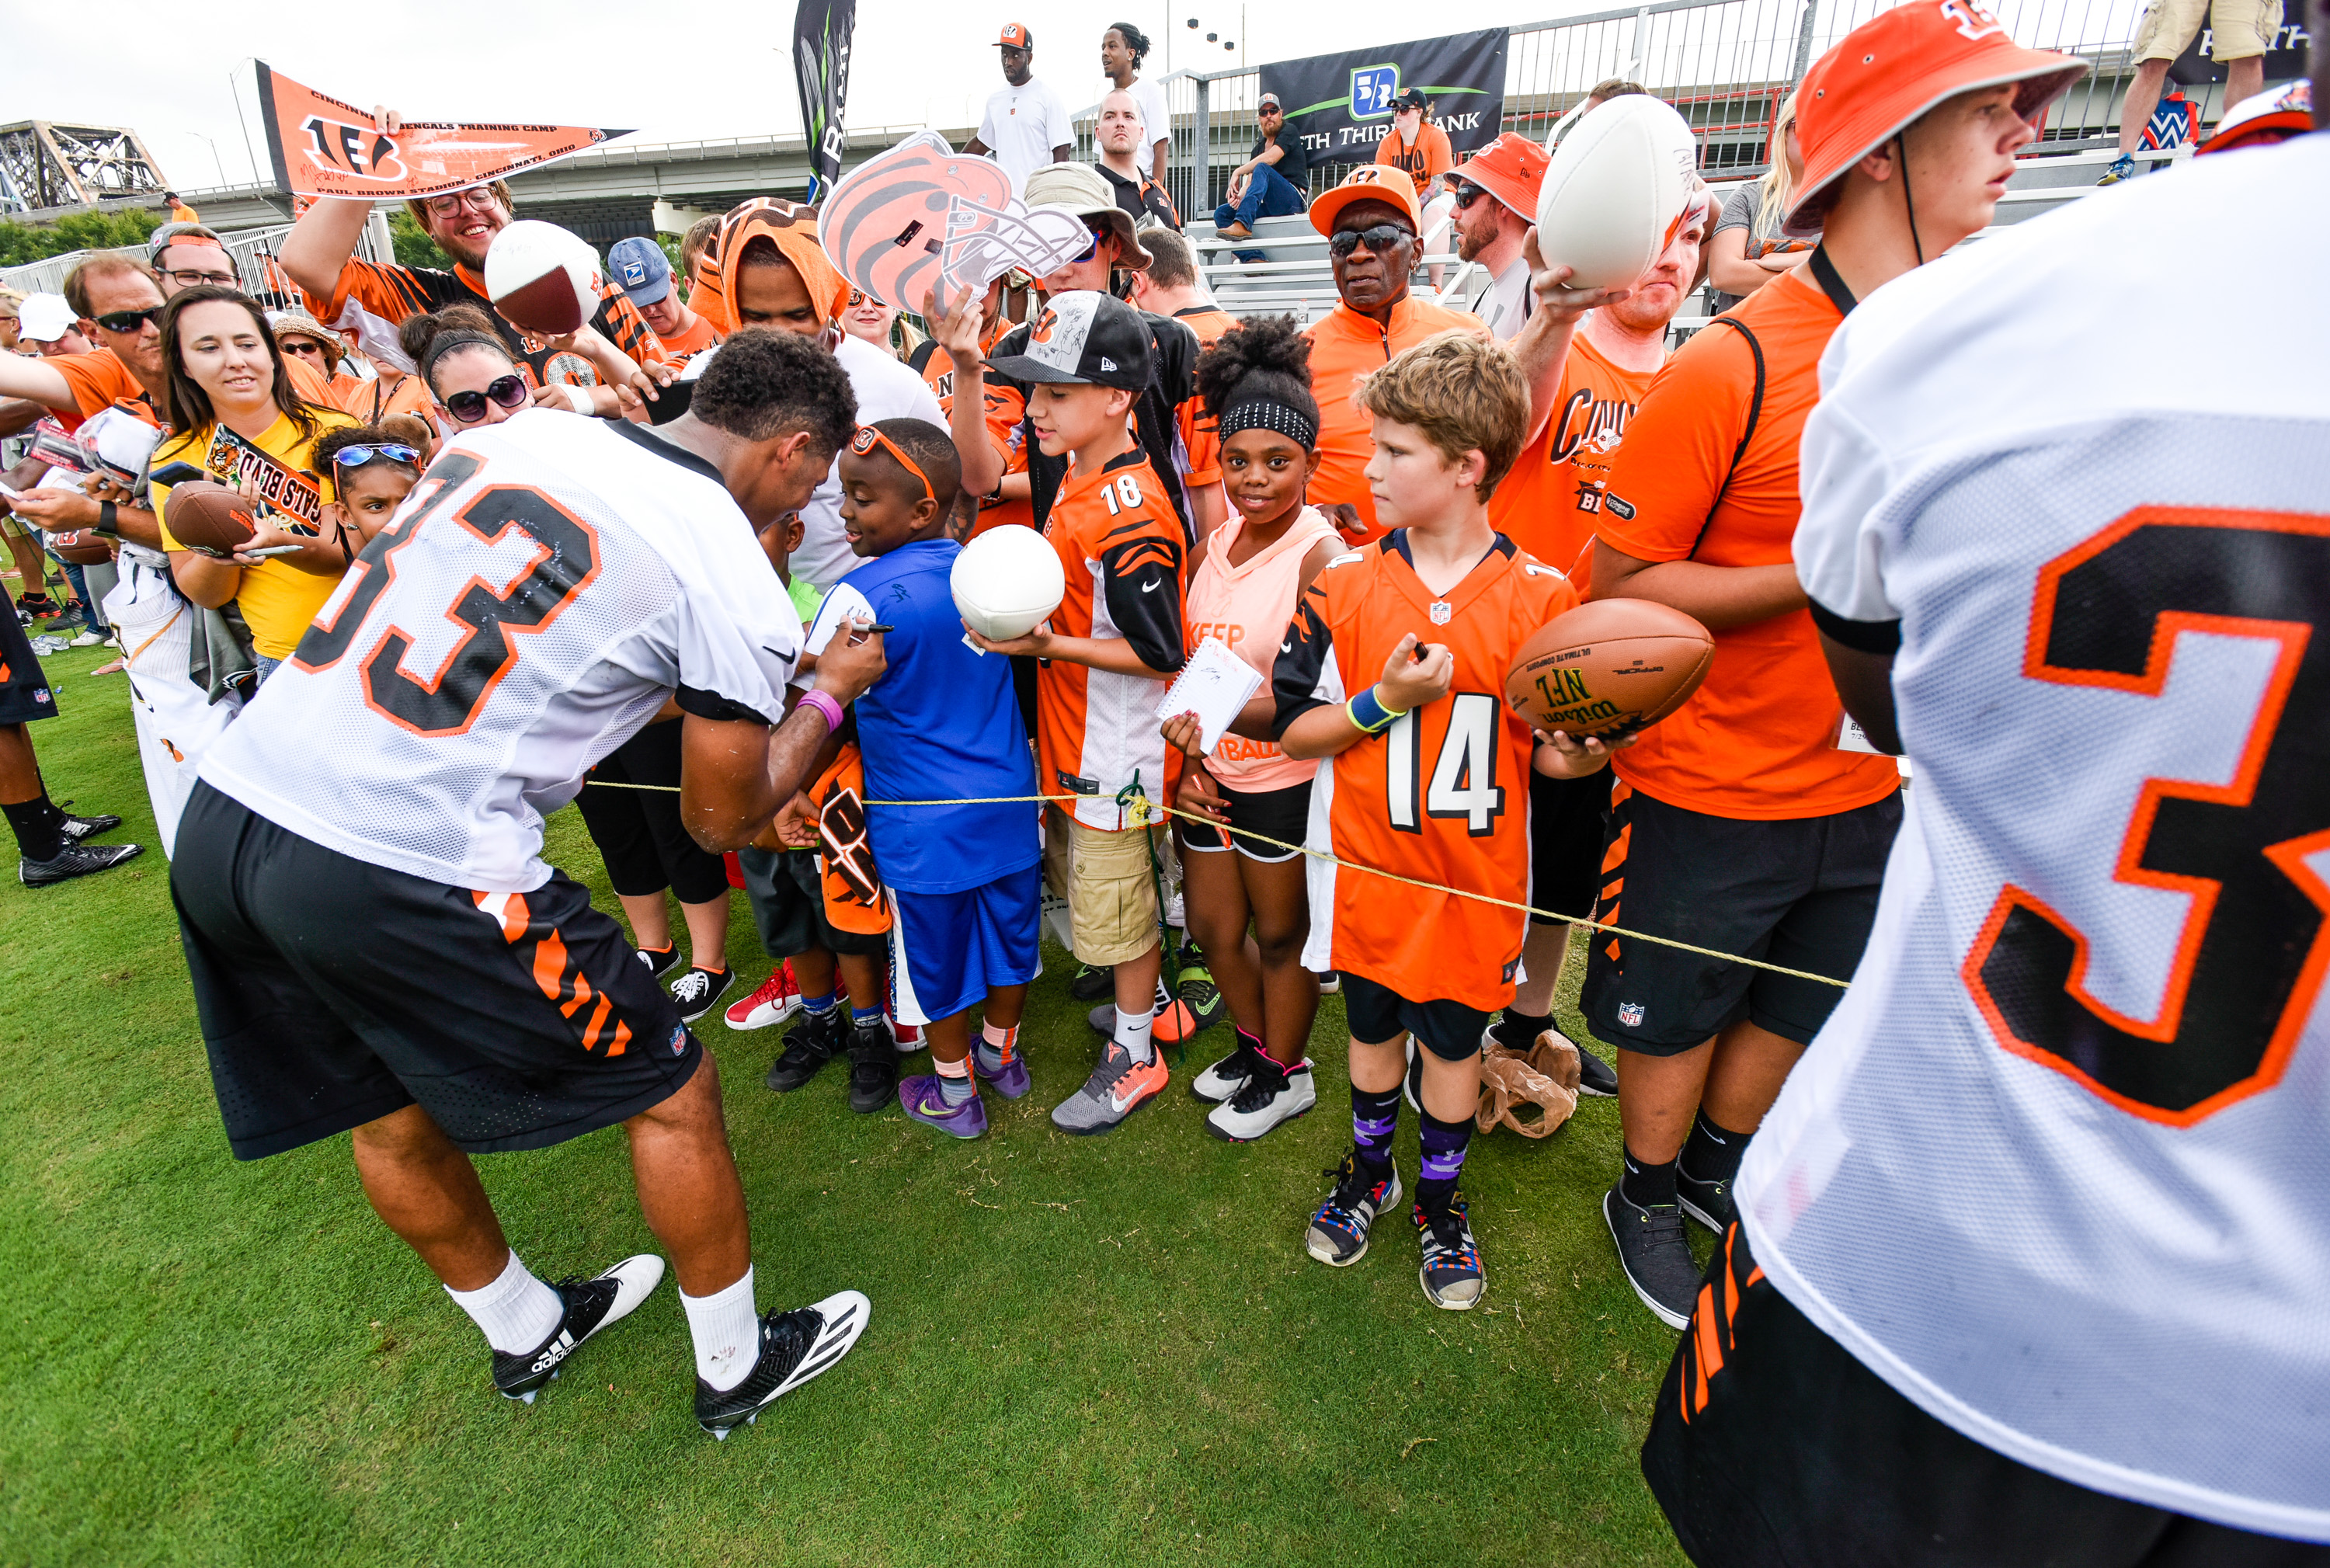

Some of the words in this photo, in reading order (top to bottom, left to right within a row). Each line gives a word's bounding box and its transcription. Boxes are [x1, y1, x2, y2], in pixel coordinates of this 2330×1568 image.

[316, 186, 353, 196] PAUL
[409, 179, 467, 194] STADIUM
[549, 144, 576, 156] OHIO
[1100, 475, 1144, 516] 18
[1434, 611, 1448, 621] NFL
[1556, 648, 1591, 662] ULTIMATE
[1535, 668, 1592, 708] NFL
[1542, 700, 1622, 725] Wilson
[1372, 691, 1506, 838] 14
[1622, 1012, 1639, 1024] NFL
[673, 1034, 687, 1053] NFL
[531, 1340, 579, 1373] adidas
